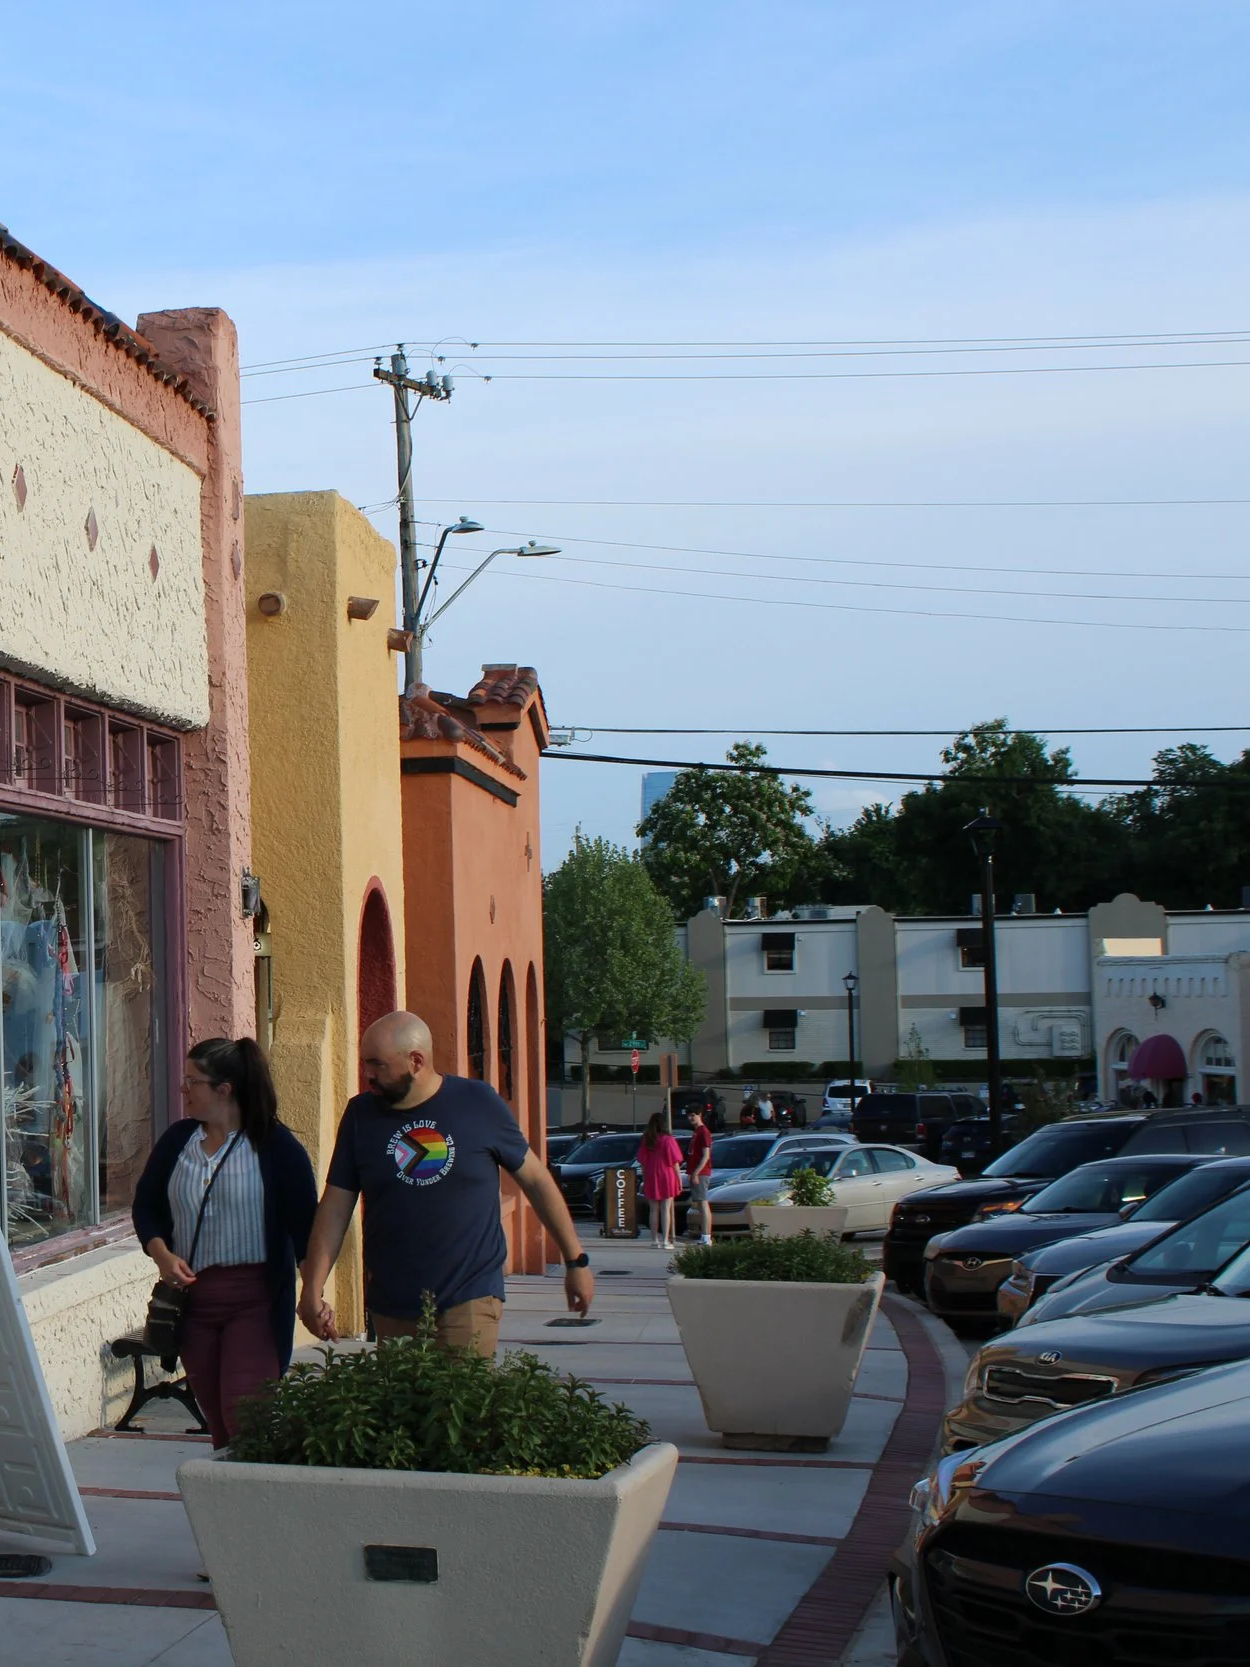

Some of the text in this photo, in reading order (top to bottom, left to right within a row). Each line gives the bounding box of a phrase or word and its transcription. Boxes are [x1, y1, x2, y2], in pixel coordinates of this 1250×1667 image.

[386, 1120, 437, 1155] BREW IS LOVE
[616, 1169, 626, 1227] COFFEE
